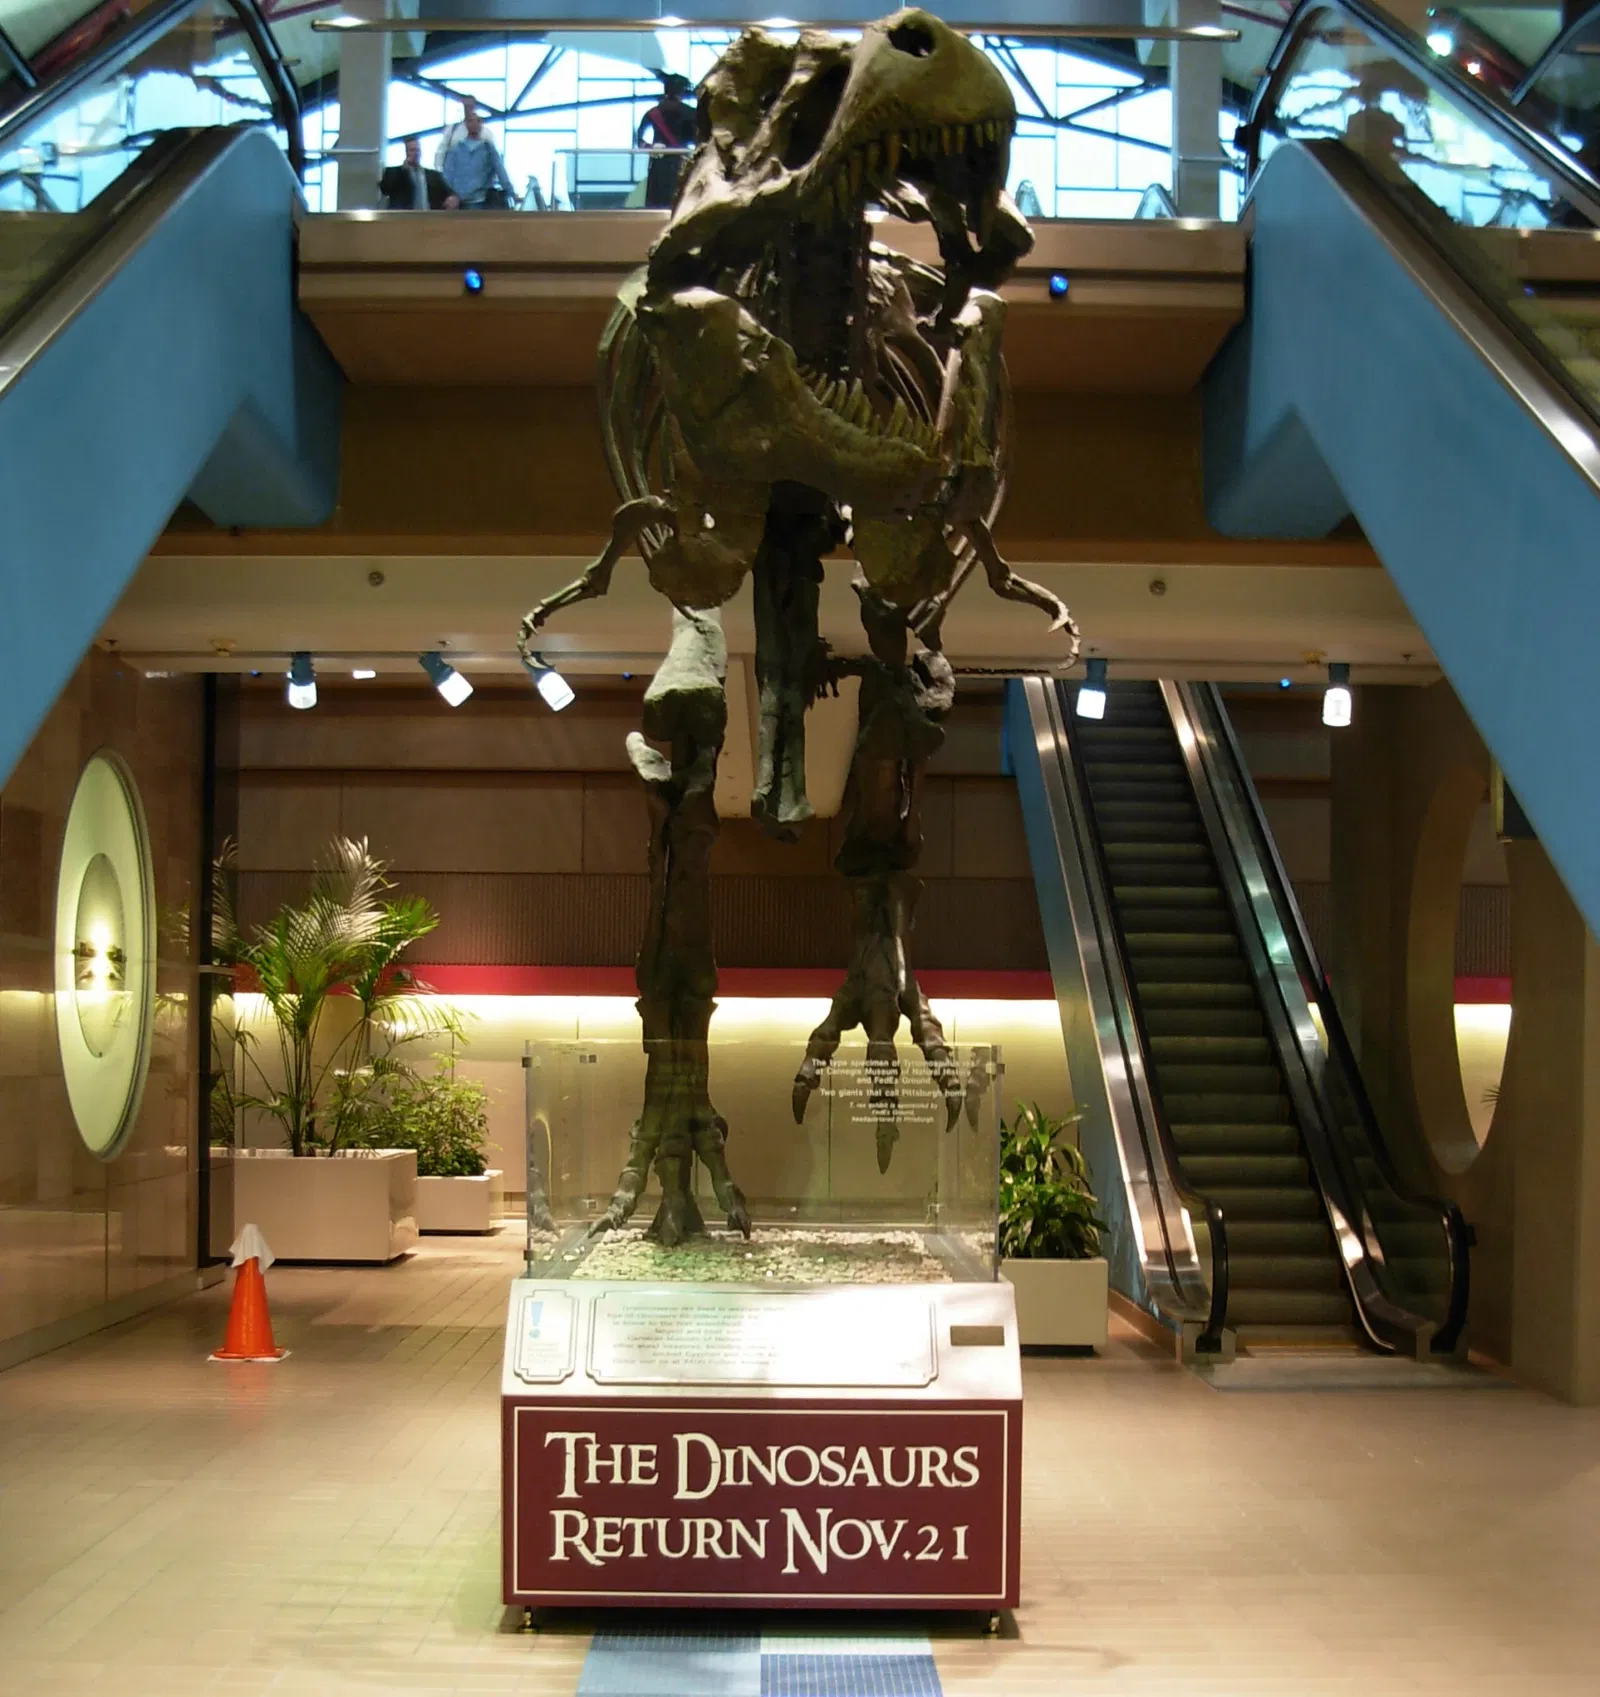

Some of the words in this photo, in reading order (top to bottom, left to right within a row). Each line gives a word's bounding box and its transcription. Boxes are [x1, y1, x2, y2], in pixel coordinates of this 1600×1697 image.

[812, 1059, 826, 1067] The
[830, 1059, 848, 1069] type
[851, 1059, 889, 1069] specimen
[892, 1059, 900, 1067] of
[815, 1068, 824, 1076] at
[826, 1067, 862, 1077] Carnegie
[866, 1068, 898, 1076] Museum
[902, 1068, 910, 1076] of
[912, 1068, 940, 1076] Natural
[943, 1068, 972, 1078] History
[856, 1076, 872, 1084] and
[874, 1076, 899, 1084] FedEx
[820, 1088, 836, 1097] Two
[838, 1088, 864, 1098] giants
[866, 1088, 882, 1097] that
[885, 1088, 900, 1097] call
[902, 1088, 942, 1099] Pittsburgh
[944, 1088, 966, 1097] home
[544, 1431, 660, 1500] THE
[672, 1432, 980, 1501] DINOSAURS
[549, 1508, 771, 1568] RETURN
